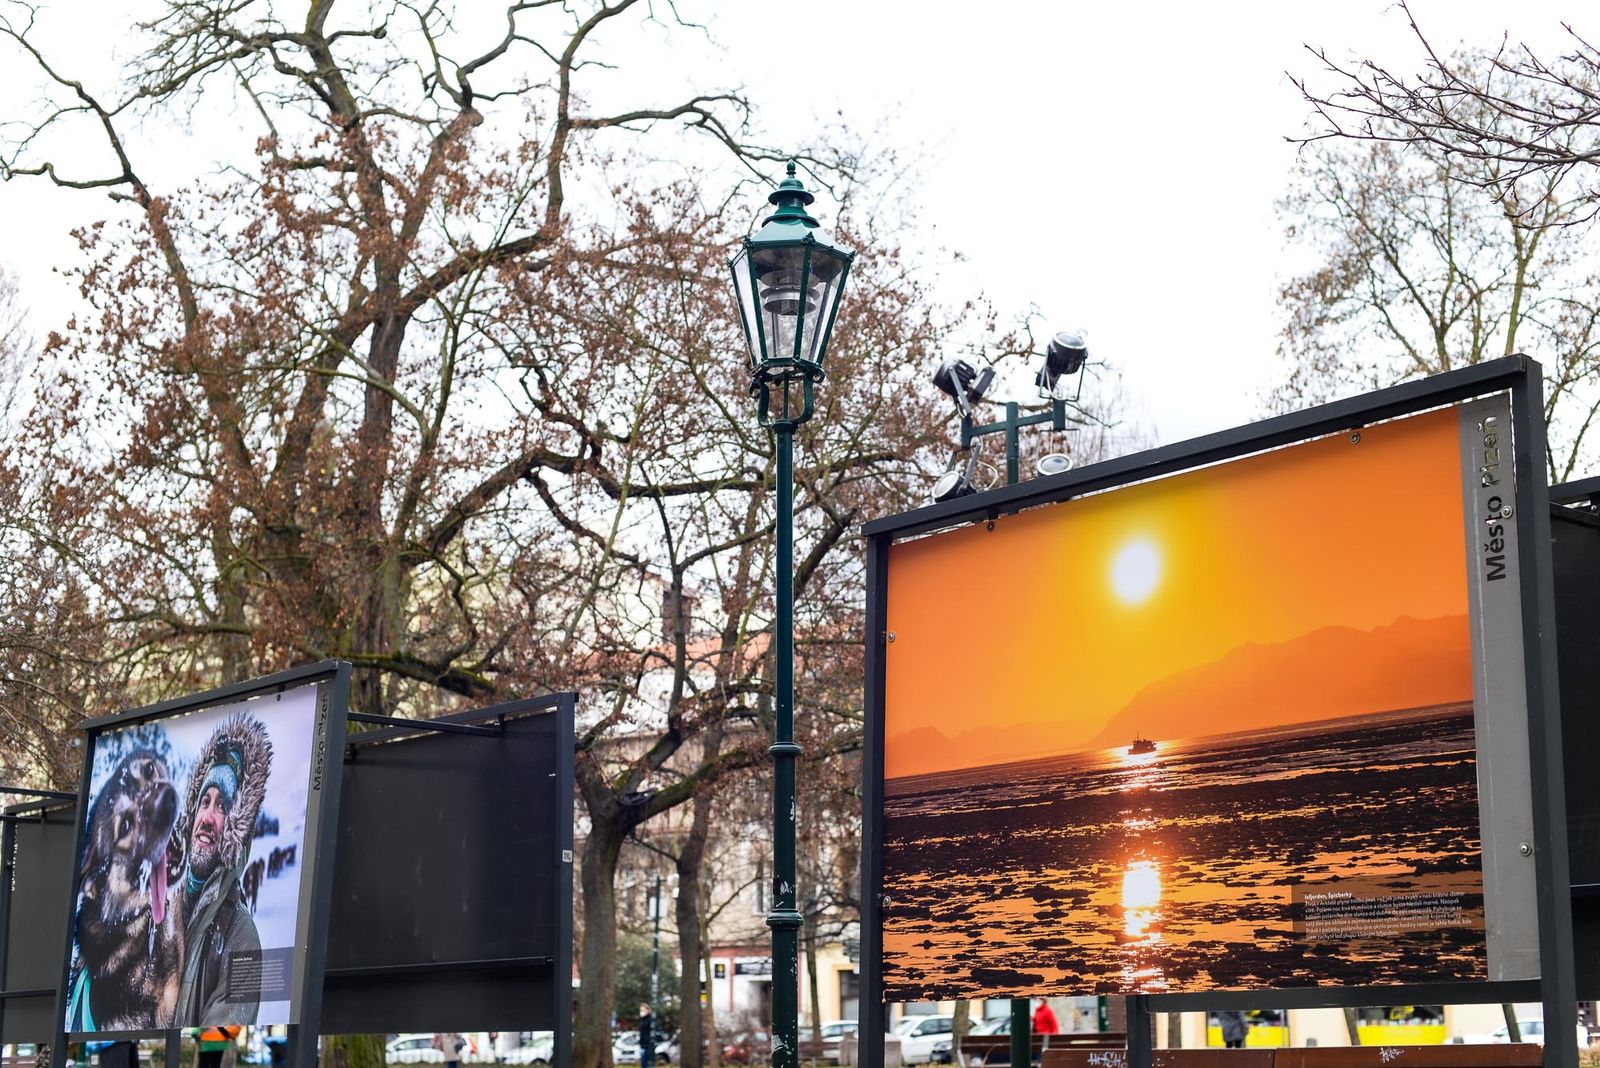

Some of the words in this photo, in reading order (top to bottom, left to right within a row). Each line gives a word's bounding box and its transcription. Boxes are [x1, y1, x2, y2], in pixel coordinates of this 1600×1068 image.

[1478, 416, 1500, 488] Plzeň
[1484, 496, 1506, 582] Město
[314, 740, 325, 791] Město
